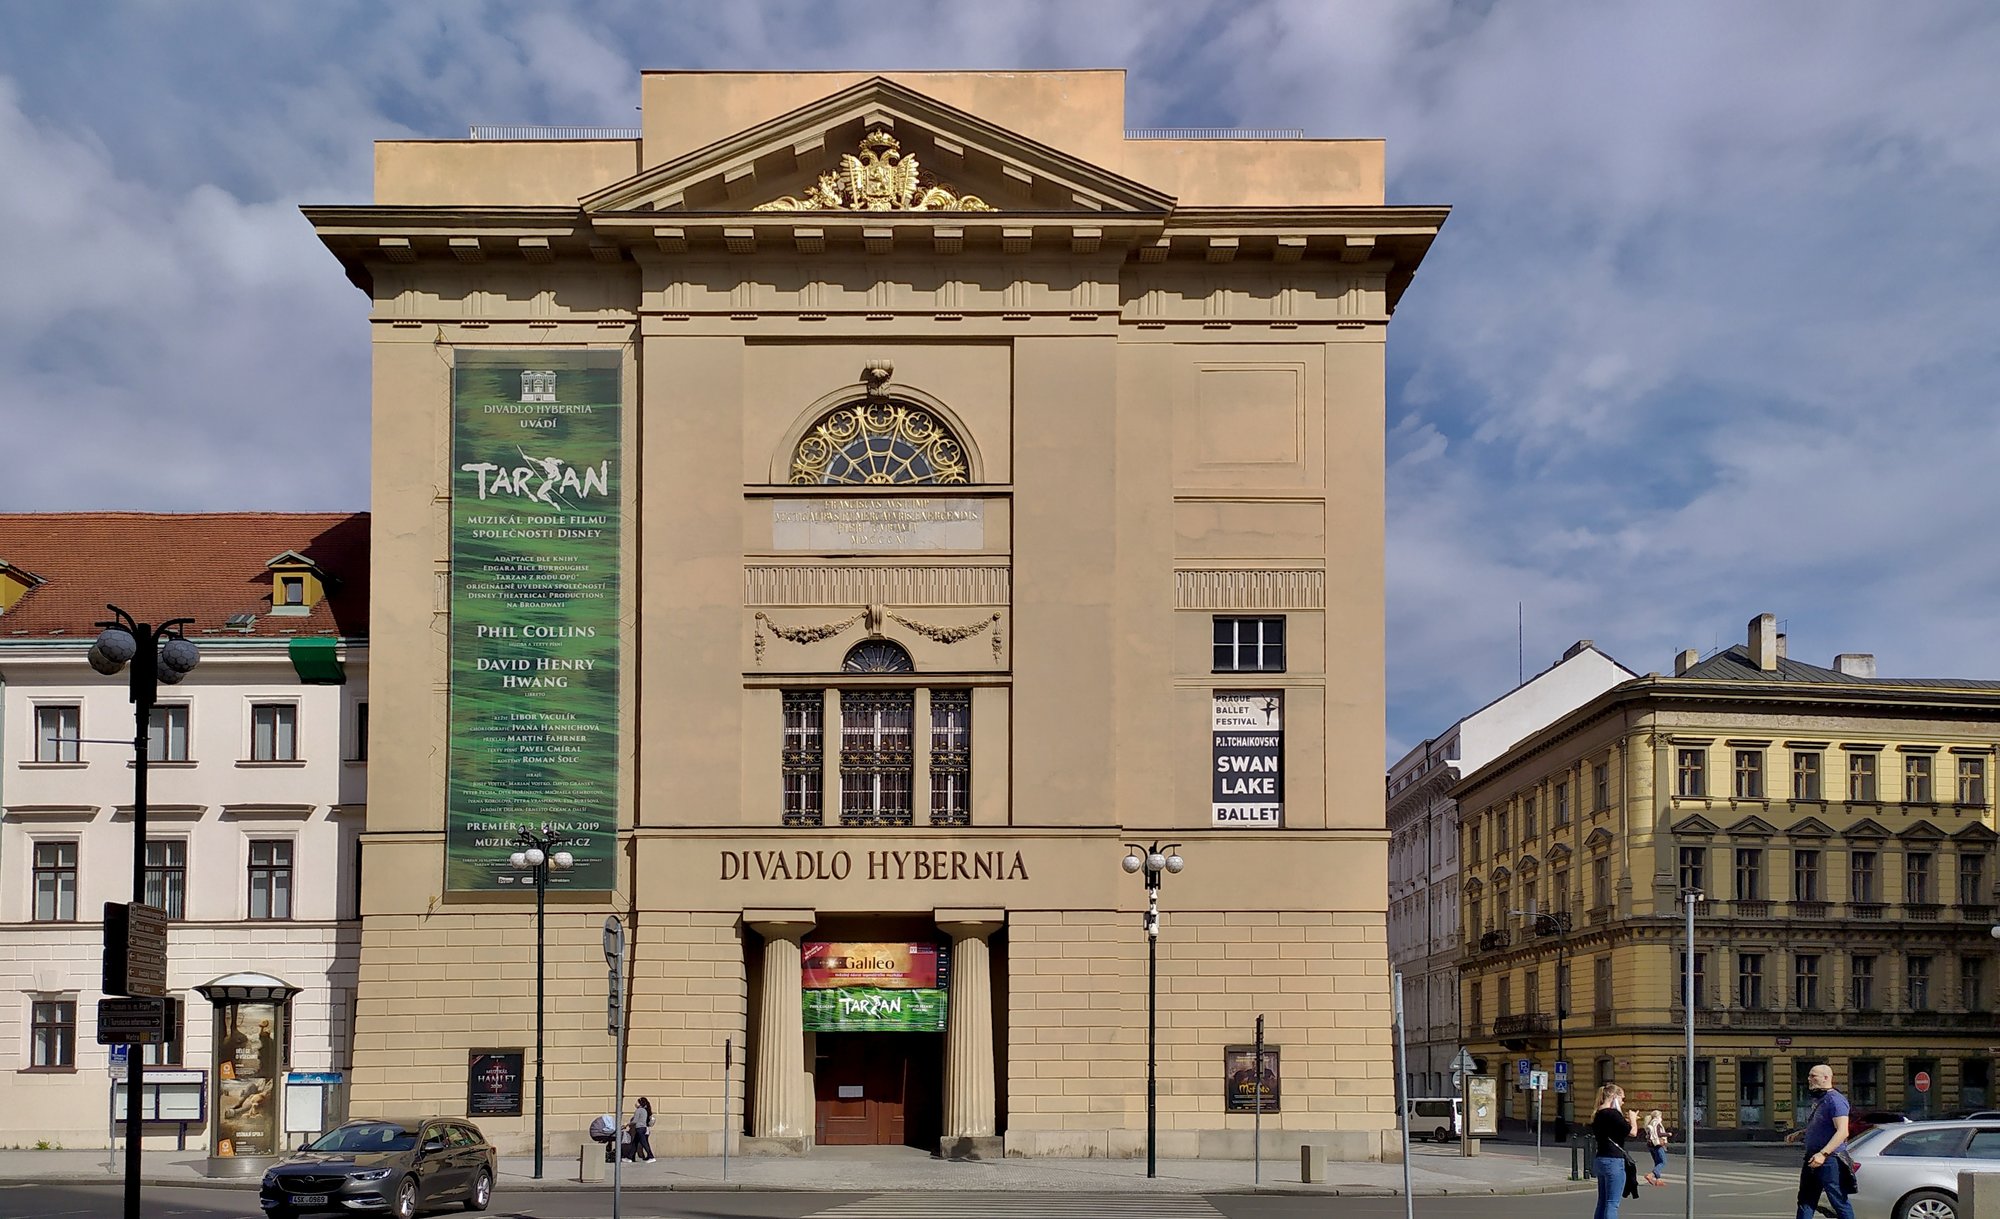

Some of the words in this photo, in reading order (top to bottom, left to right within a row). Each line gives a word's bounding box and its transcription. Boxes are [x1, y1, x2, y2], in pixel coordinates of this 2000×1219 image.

[484, 405, 534, 413] DIVADLO
[537, 405, 592, 413] HYBERNIA
[520, 418, 556, 428] UVÁDÍ
[462, 459, 608, 508] TARZAN
[468, 515, 522, 524] MUZIKÁL
[528, 516, 566, 524] PODLE
[570, 516, 606, 524] FILMU
[472, 529, 553, 538] SPOLEČNOSTI
[558, 529, 601, 538] DISNEY
[477, 626, 518, 638] PHIL
[523, 626, 595, 638] COLLINS
[477, 658, 530, 670] DAVID
[536, 658, 595, 670] HENRY
[502, 676, 568, 688] HWANG
[1217, 756, 1278, 772] SWAN
[1222, 778, 1274, 794] LAKE
[1217, 808, 1279, 820] BALLET
[720, 850, 852, 880] DIVADLO
[867, 850, 1028, 880] HYBERNIA
[846, 957, 894, 969] Galileo
[838, 996, 901, 1016] TARZAN
